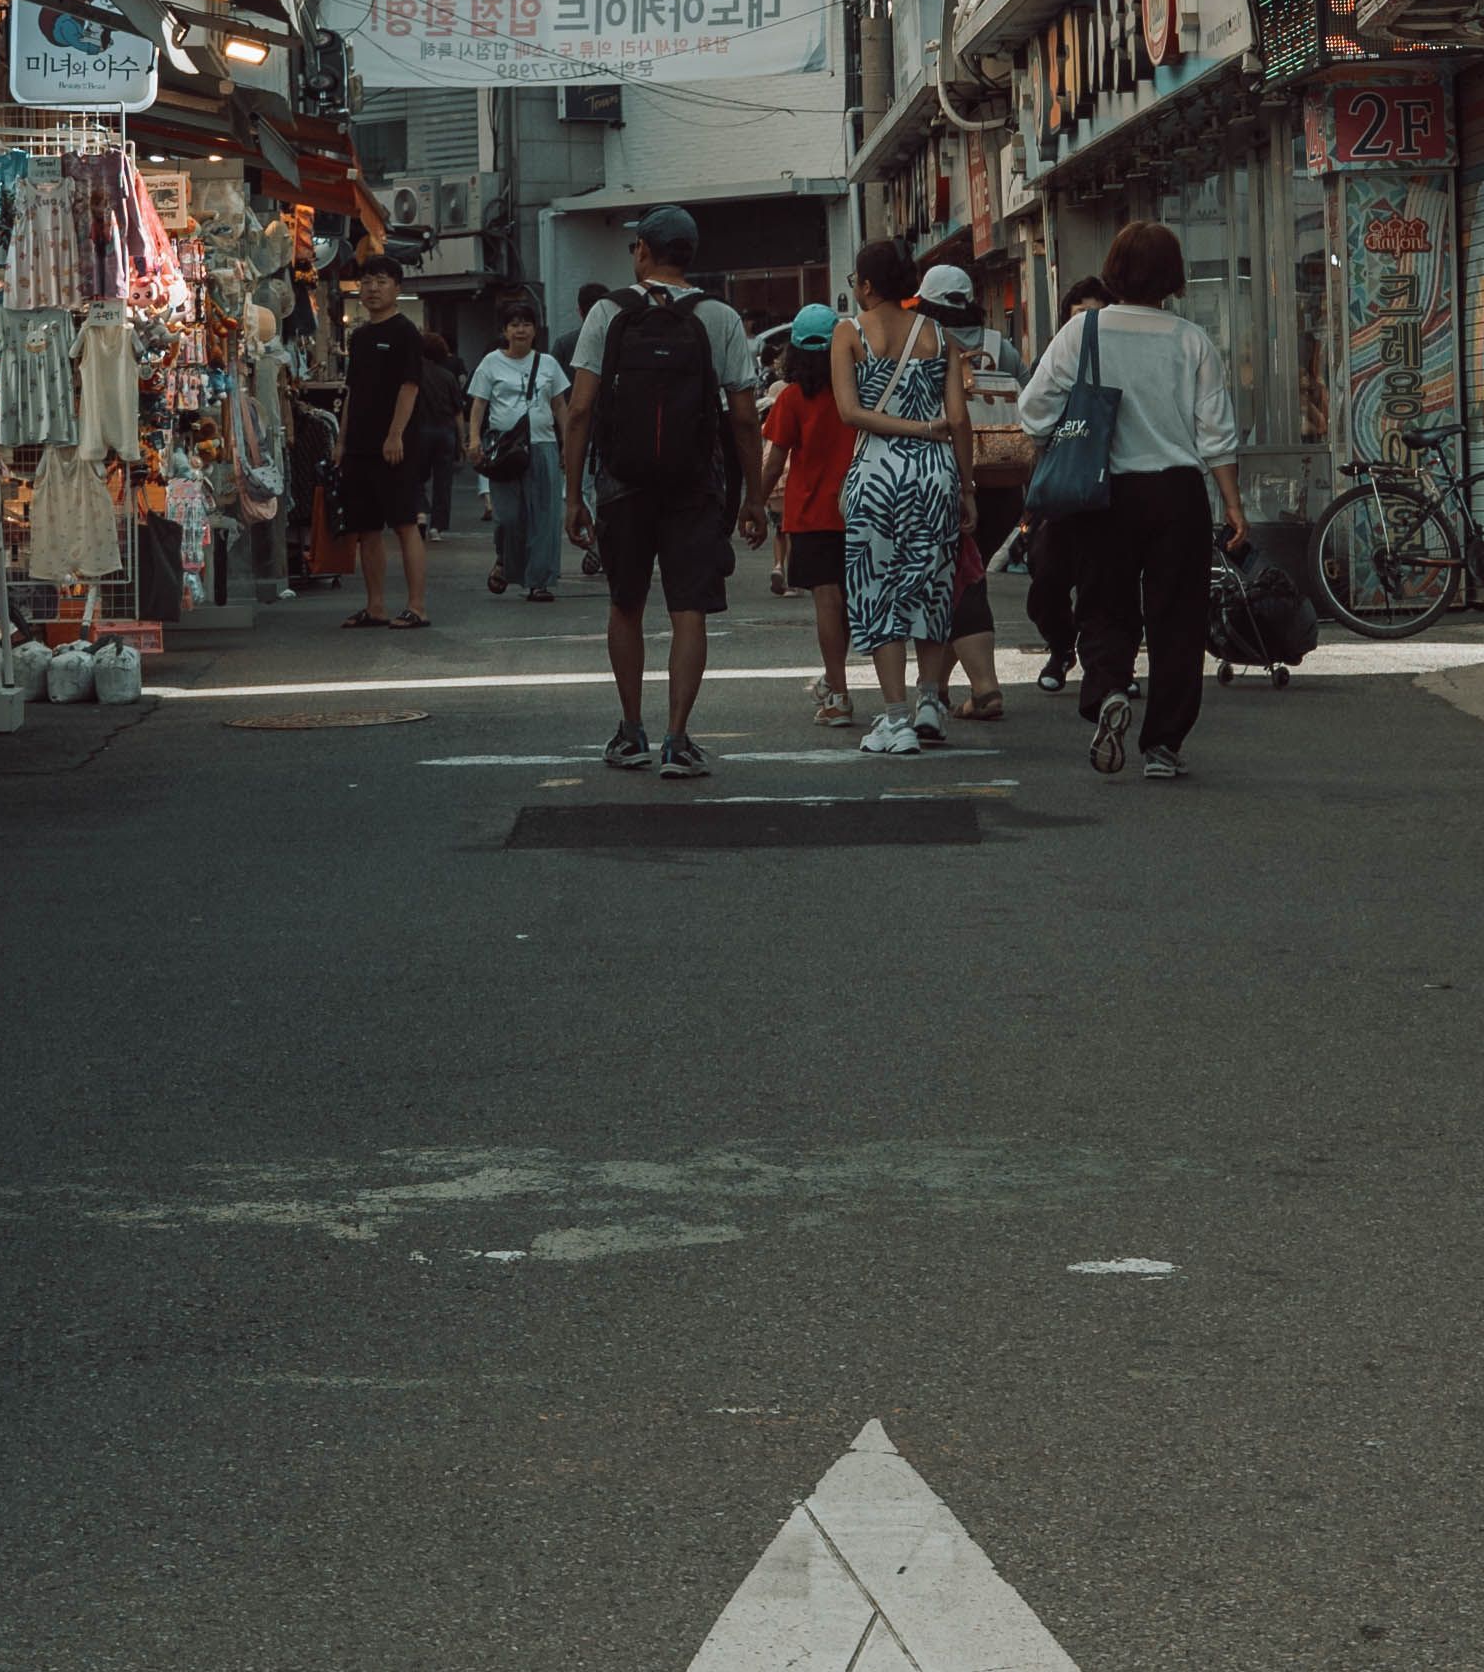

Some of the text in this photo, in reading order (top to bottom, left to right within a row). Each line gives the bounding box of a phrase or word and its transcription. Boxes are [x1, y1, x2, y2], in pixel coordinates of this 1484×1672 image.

[26, 52, 140, 81] 미녀와 야수
[1348, 91, 1434, 157] 2F
